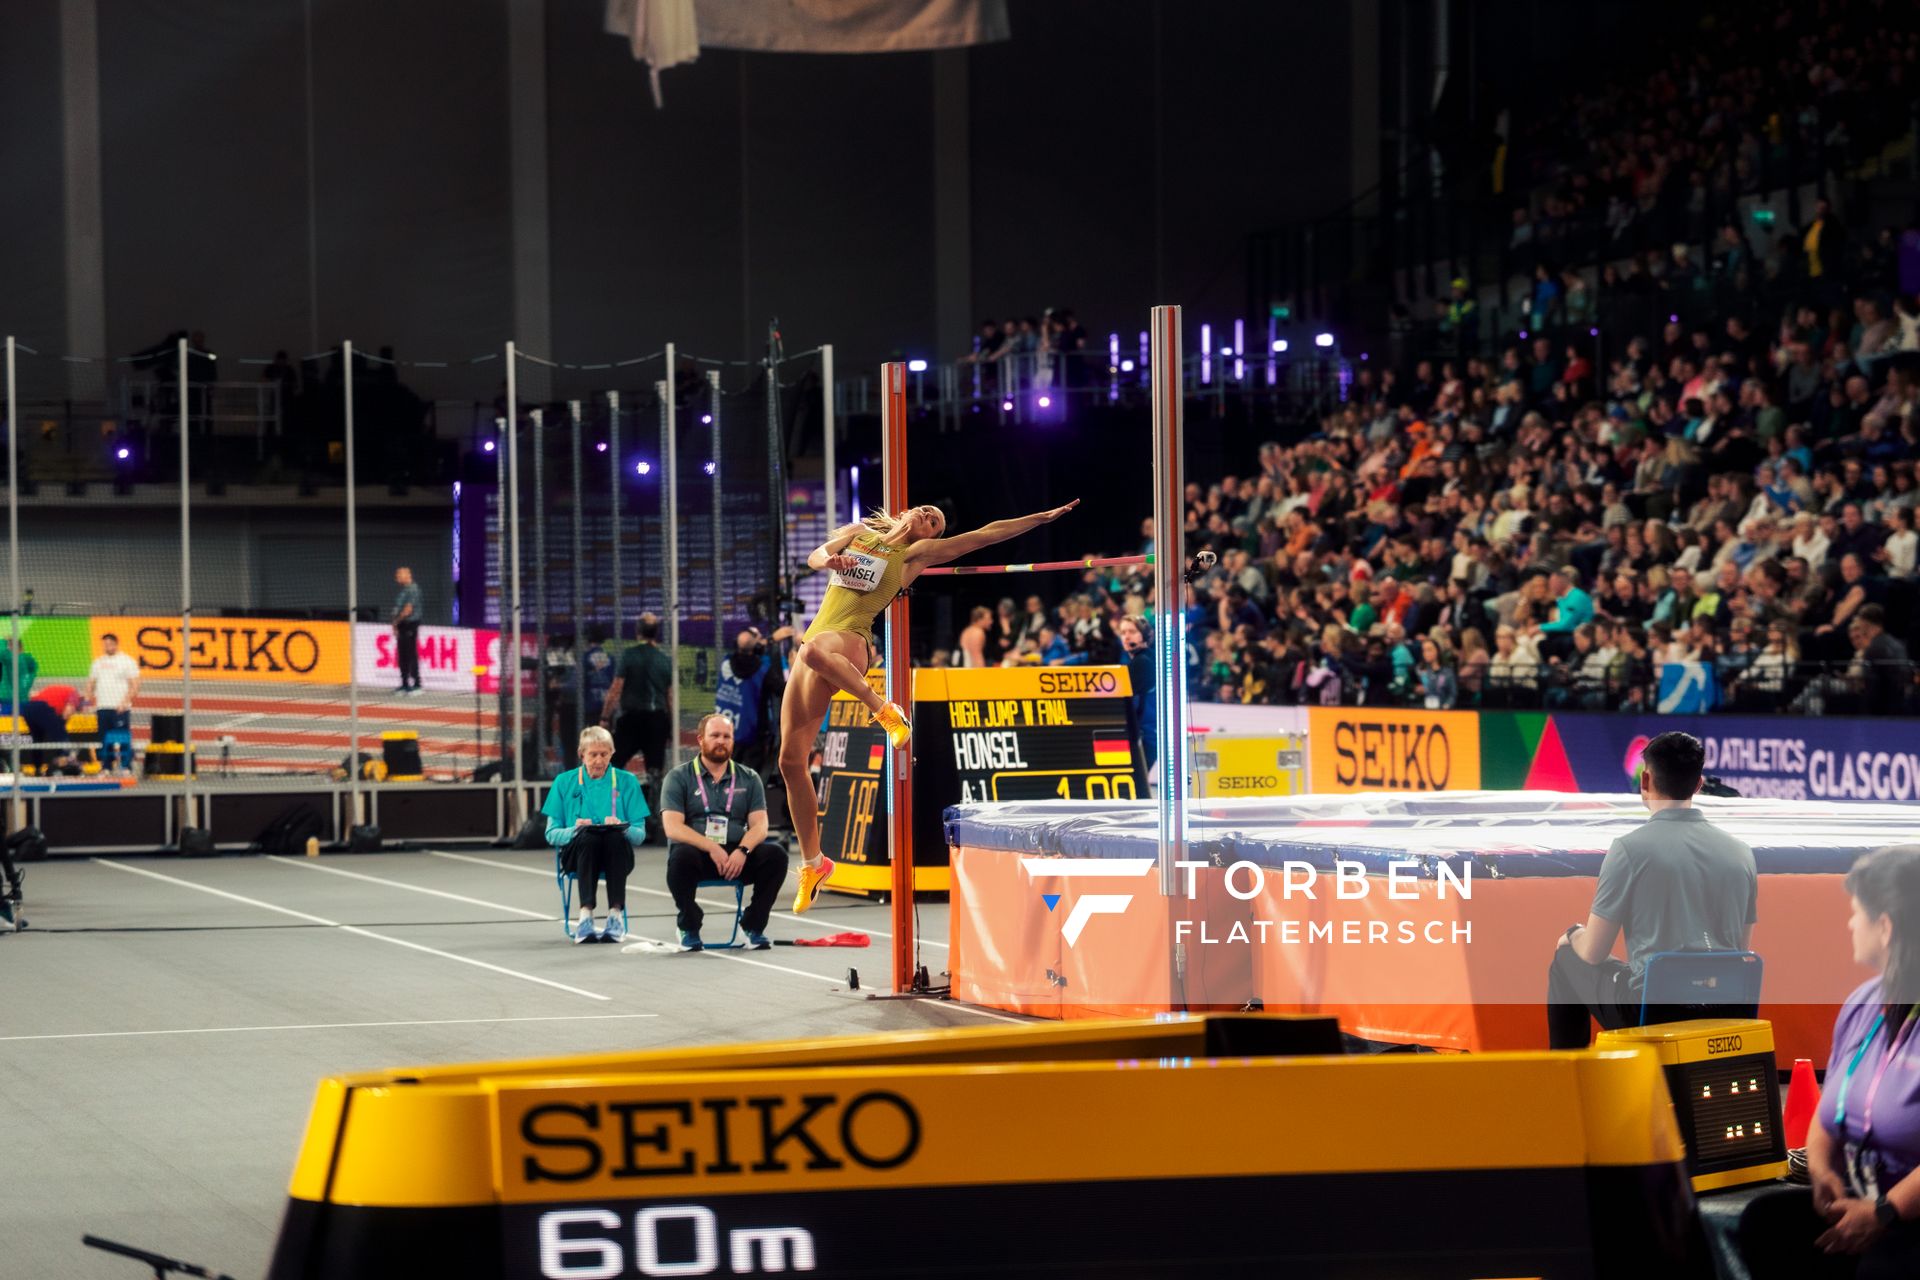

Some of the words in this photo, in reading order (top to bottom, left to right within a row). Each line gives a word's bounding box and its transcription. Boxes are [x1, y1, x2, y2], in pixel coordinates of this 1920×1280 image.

[137, 626, 319, 672] SEIKO
[376, 634, 457, 671] SMH
[1039, 671, 1117, 693] SEIKO
[949, 701, 980, 728] HIGH
[985, 700, 1019, 727] JUMP
[1022, 700, 1034, 726] W
[1036, 699, 1073, 726] FINAL
[953, 731, 1028, 770] HONSEL
[1334, 721, 1450, 791] SEIKO
[1719, 737, 1806, 773] ATHLETICS
[1218, 775, 1278, 790] SEIKO
[1707, 1035, 1742, 1055] SEIKO
[520, 1089, 923, 1183] SEIKO
[538, 1204, 817, 1280] 60m
